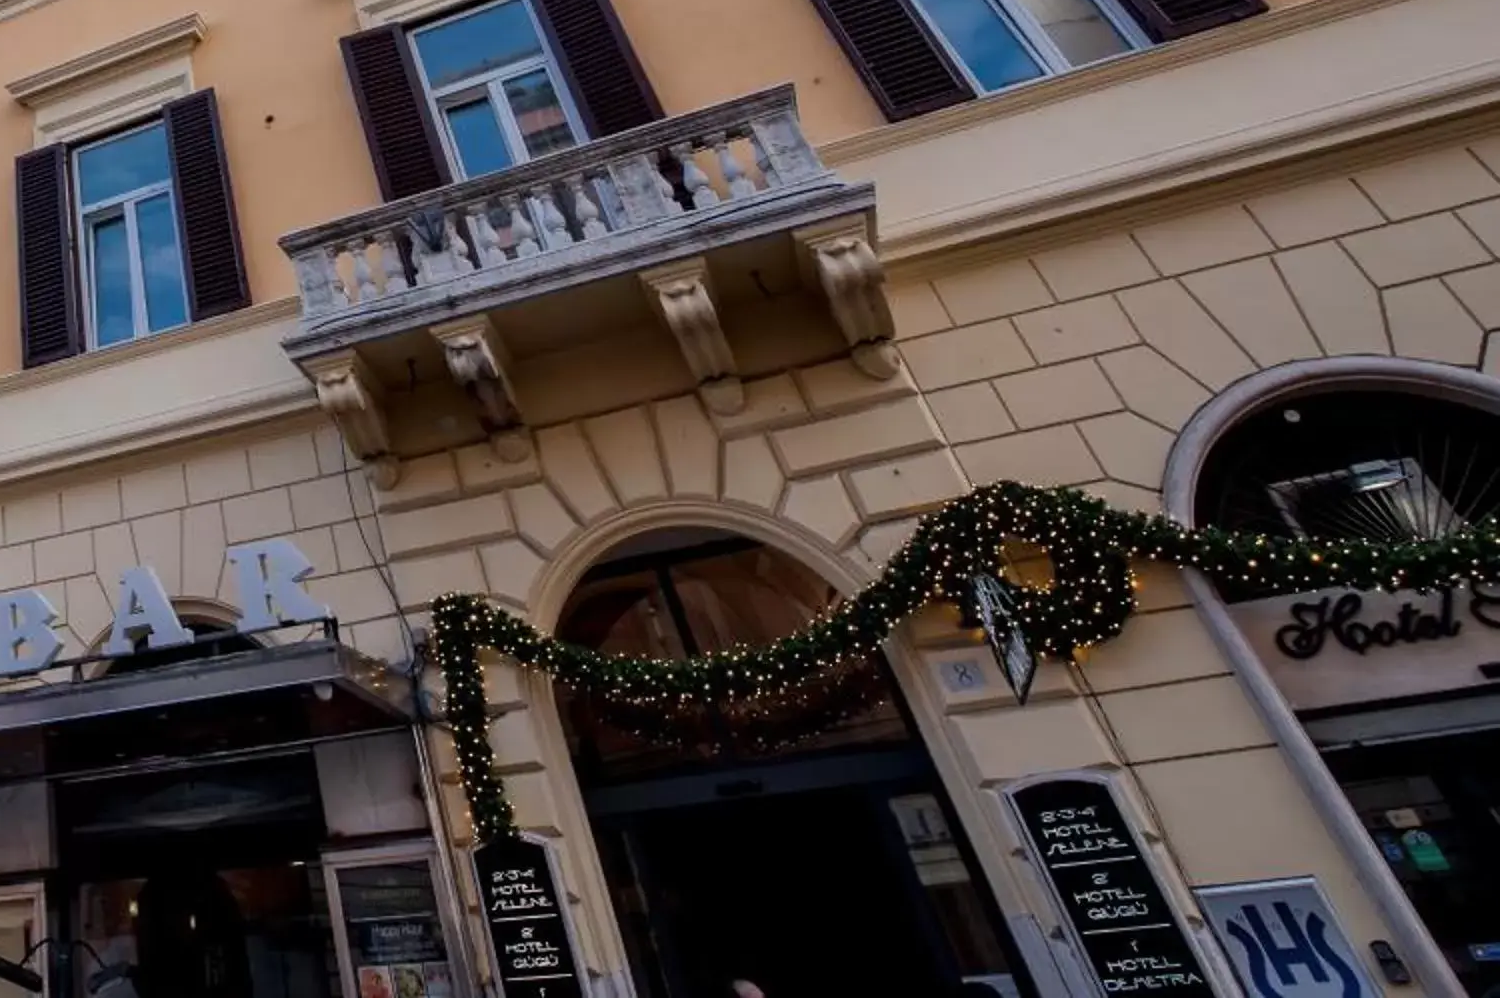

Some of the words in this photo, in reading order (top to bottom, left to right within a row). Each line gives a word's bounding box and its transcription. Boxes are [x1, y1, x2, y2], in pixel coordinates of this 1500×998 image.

[1275, 580, 1462, 660] Hotel
[1041, 823, 1113, 840] HOTEL
[1046, 837, 1129, 857] SELENE
[491, 882, 545, 897] HOTEL
[1072, 886, 1148, 905] HOTEL
[505, 941, 560, 954] HOTEL
[1105, 955, 1183, 973] HOTEL
[1103, 972, 1203, 992] DEMETRA
